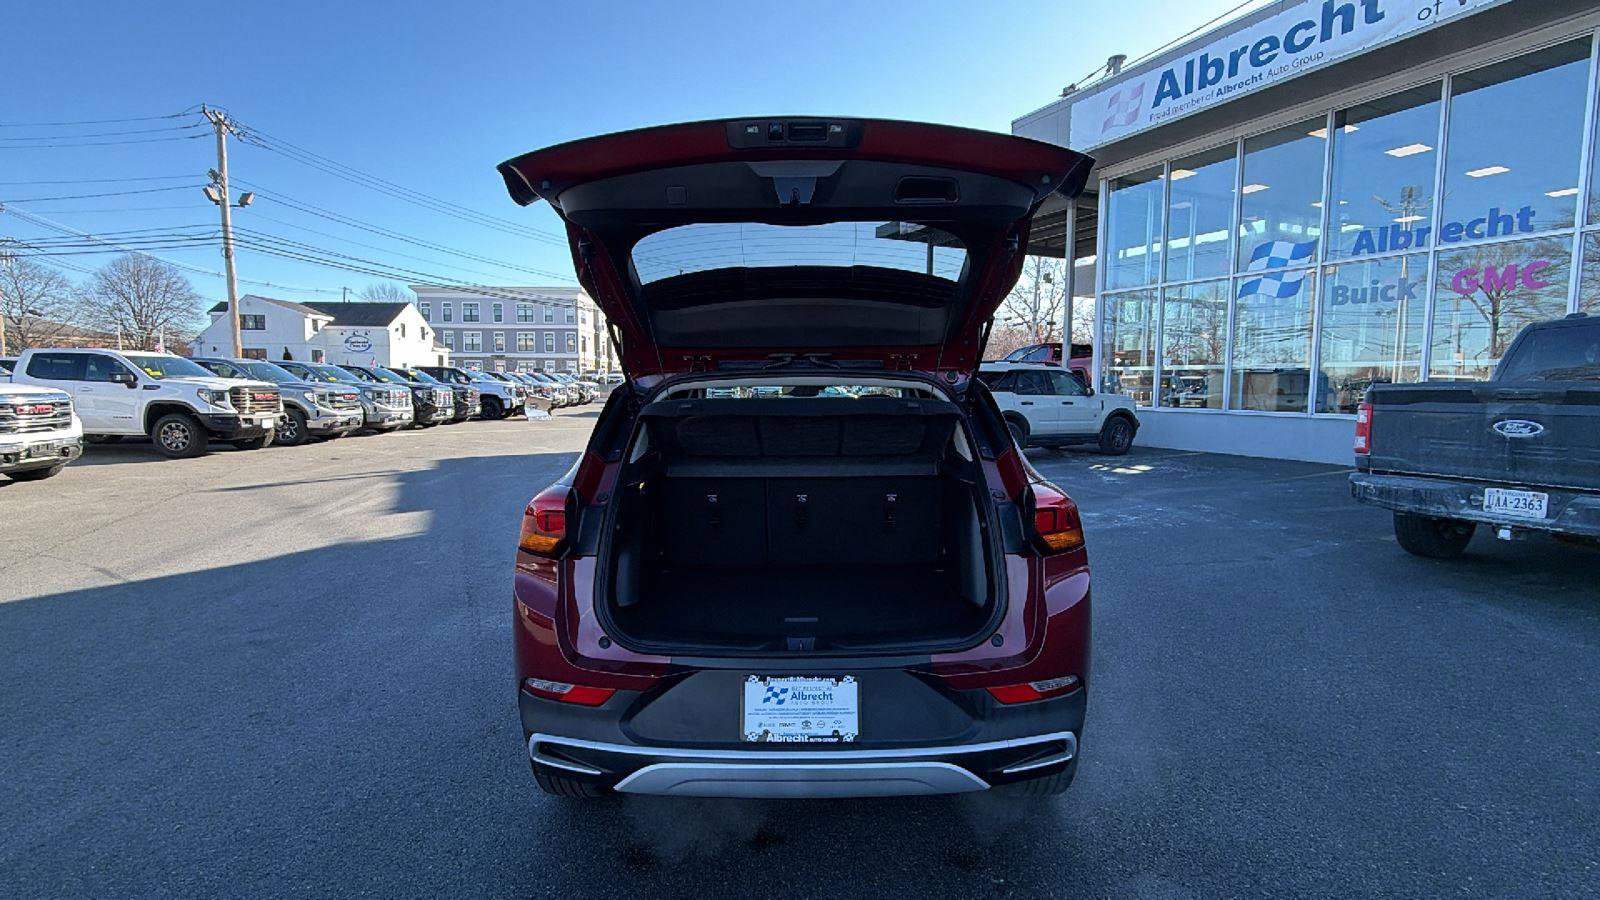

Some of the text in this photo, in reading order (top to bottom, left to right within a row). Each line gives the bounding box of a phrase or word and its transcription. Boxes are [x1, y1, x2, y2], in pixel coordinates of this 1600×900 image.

[1152, 0, 1386, 109] Albrecht
[1172, 96, 1205, 114] member
[1216, 72, 1263, 98] Albrecht
[1266, 64, 1290, 79] Auto
[1291, 51, 1324, 69] Group
[1352, 205, 1536, 256] Albrecht
[1331, 278, 1418, 306] Buick
[1452, 260, 1551, 296] GMC
[16, 404, 54, 415] GMC
[1488, 495, 1543, 511] UAA-2363
[790, 692, 833, 700] Albrecht
[766, 734, 809, 742] Albrecht
